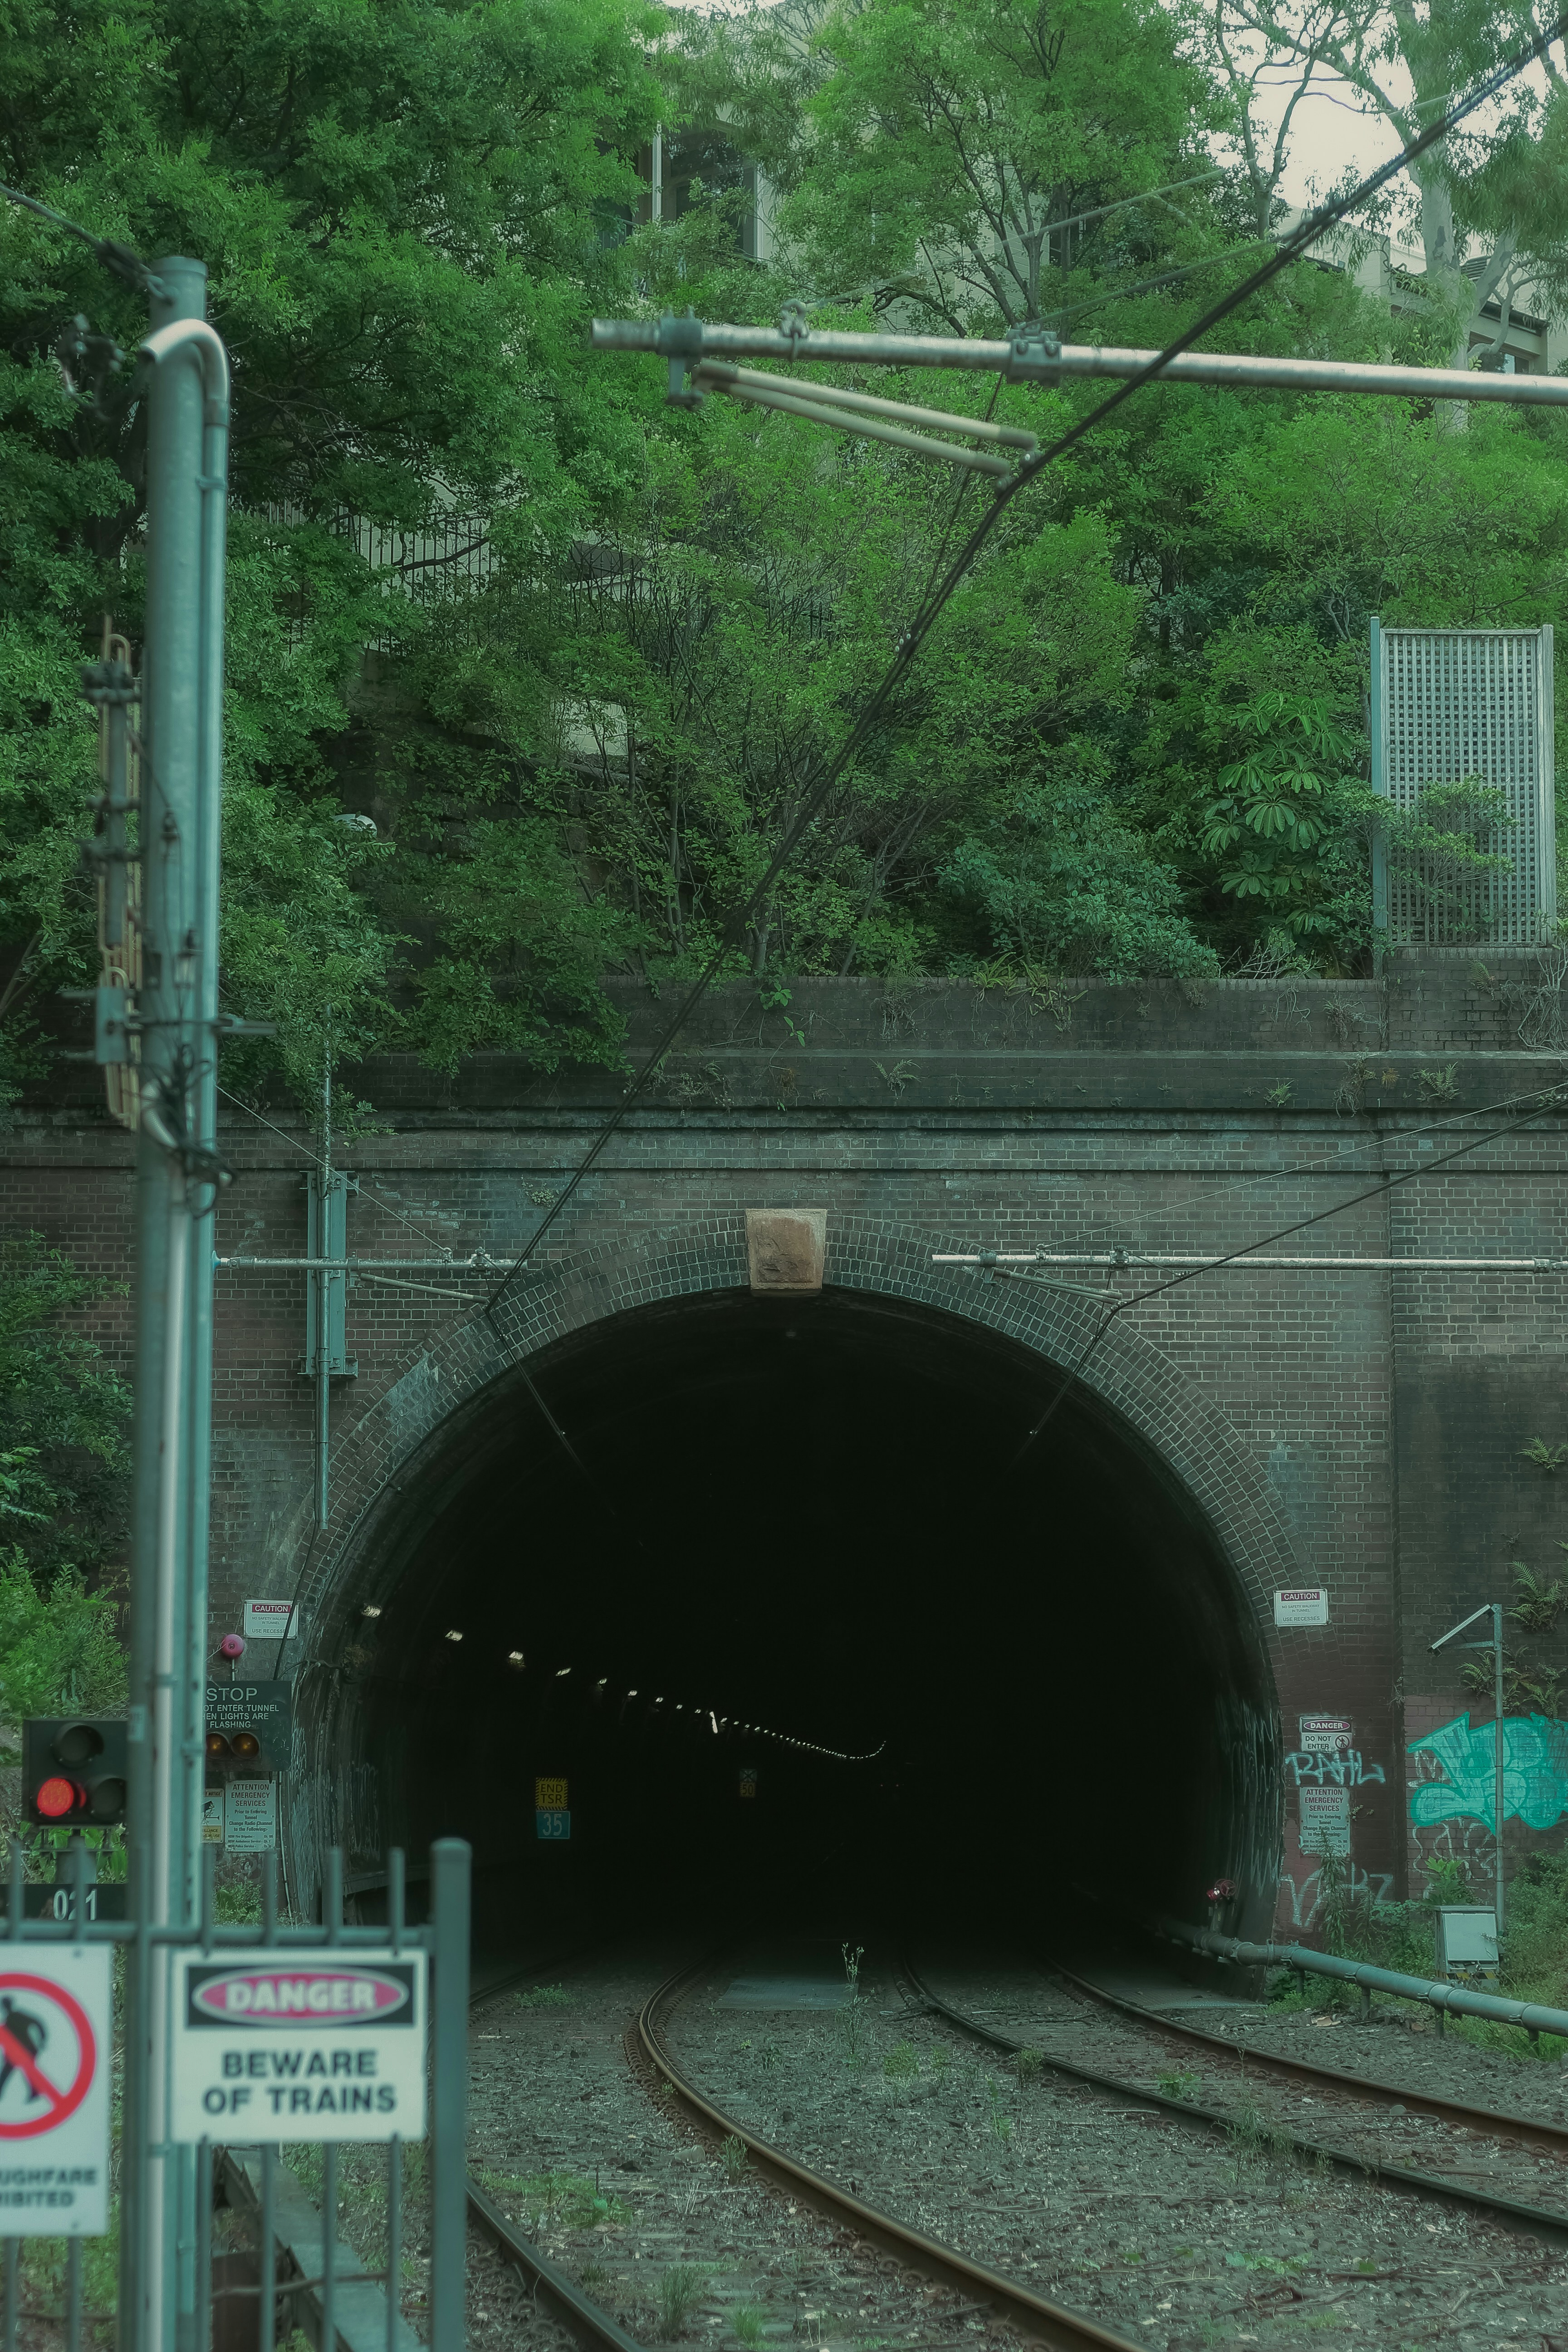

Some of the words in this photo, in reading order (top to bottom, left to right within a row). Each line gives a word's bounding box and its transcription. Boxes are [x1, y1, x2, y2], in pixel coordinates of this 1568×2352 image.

[206, 1688, 258, 1701] STOP
[540, 1784, 563, 1793] END
[743, 1784, 754, 1795] 50
[540, 1793, 563, 1804] TSR
[543, 1813, 563, 1836] 35
[226, 1979, 376, 2012] DANGER
[223, 2049, 379, 2079] BEWARE
[203, 2087, 252, 2115] OF
[266, 2087, 399, 2115] TRAINS
[0, 2168, 97, 2186] UGHFARE
